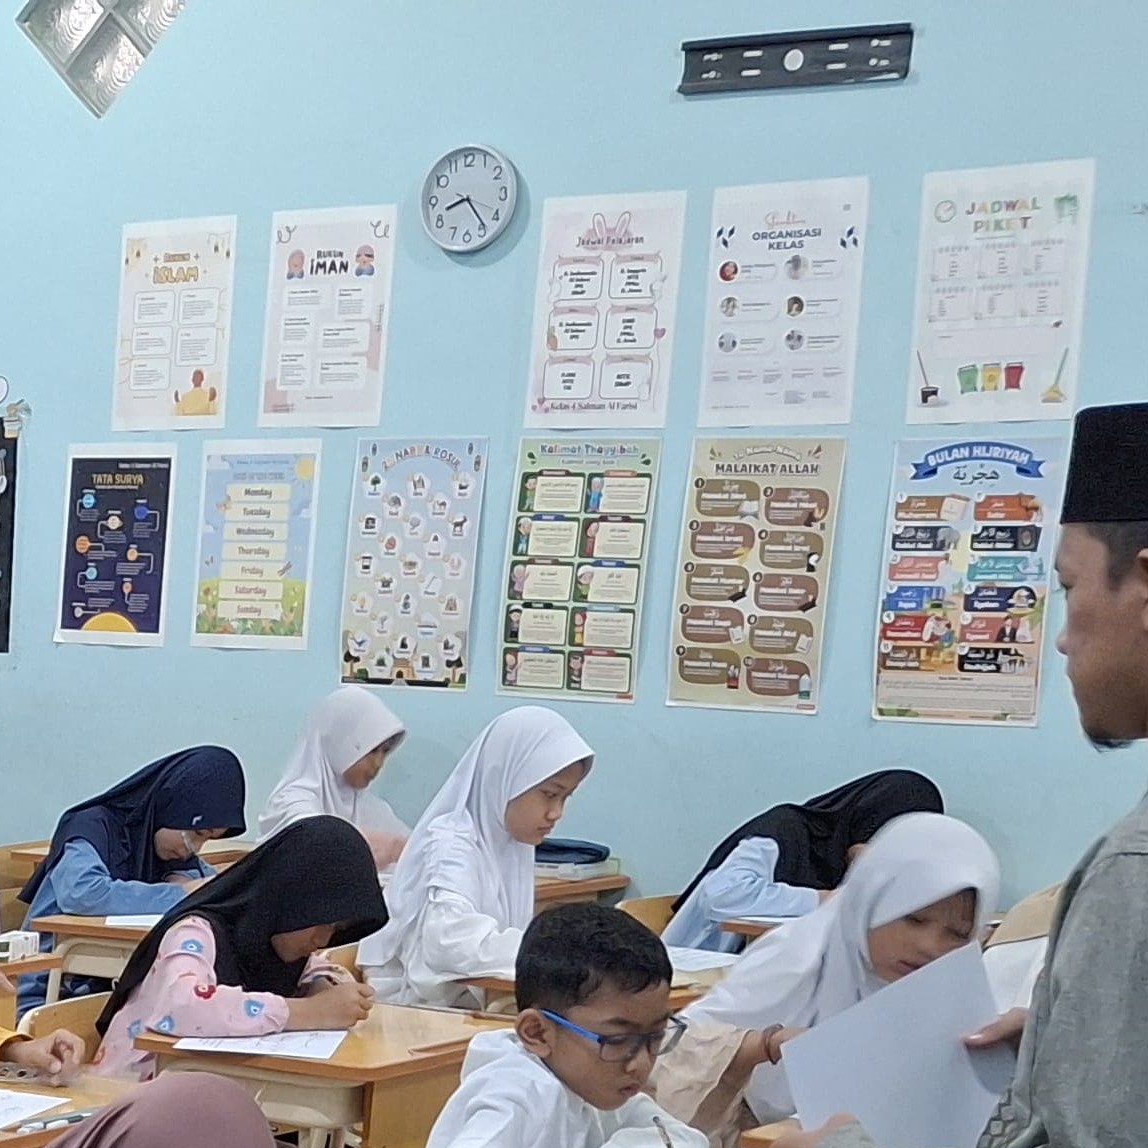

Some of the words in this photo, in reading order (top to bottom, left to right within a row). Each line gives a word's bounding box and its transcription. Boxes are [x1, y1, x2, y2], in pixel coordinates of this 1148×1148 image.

[448, 159, 458, 174] 11
[464, 152, 475, 168] 12
[493, 165, 503, 180] 2
[436, 174, 450, 189] 10
[499, 185, 508, 201] 3
[429, 195, 439, 210] 9
[965, 197, 1042, 215] JADWAL
[435, 214, 445, 229] 8
[491, 208, 500, 222] 4
[477, 224, 487, 238] 5
[973, 216, 1032, 233] PIKET
[449, 226, 458, 240] 7
[462, 228, 472, 243] 6
[752, 228, 822, 241] ORGANISASI
[576, 236, 603, 248] Jadwal
[768, 240, 805, 250] KELAS
[540, 444, 581, 454] Kalimat
[584, 443, 639, 456] Thayyibah
[927, 446, 970, 466] BULAN
[973, 445, 1030, 464] HIJRIYAH
[715, 463, 776, 473] MALAIKAT
[780, 463, 819, 473] ALLAH
[92, 473, 113, 485] TATA
[114, 473, 144, 485] SURYA
[244, 487, 273, 499] Monday
[242, 506, 271, 518] Tuesday
[236, 527, 275, 538] Wednesday
[238, 546, 270, 558] Thursday
[241, 566, 264, 578] Friday
[234, 585, 267, 597] Saturday
[237, 604, 262, 616] Sunday
